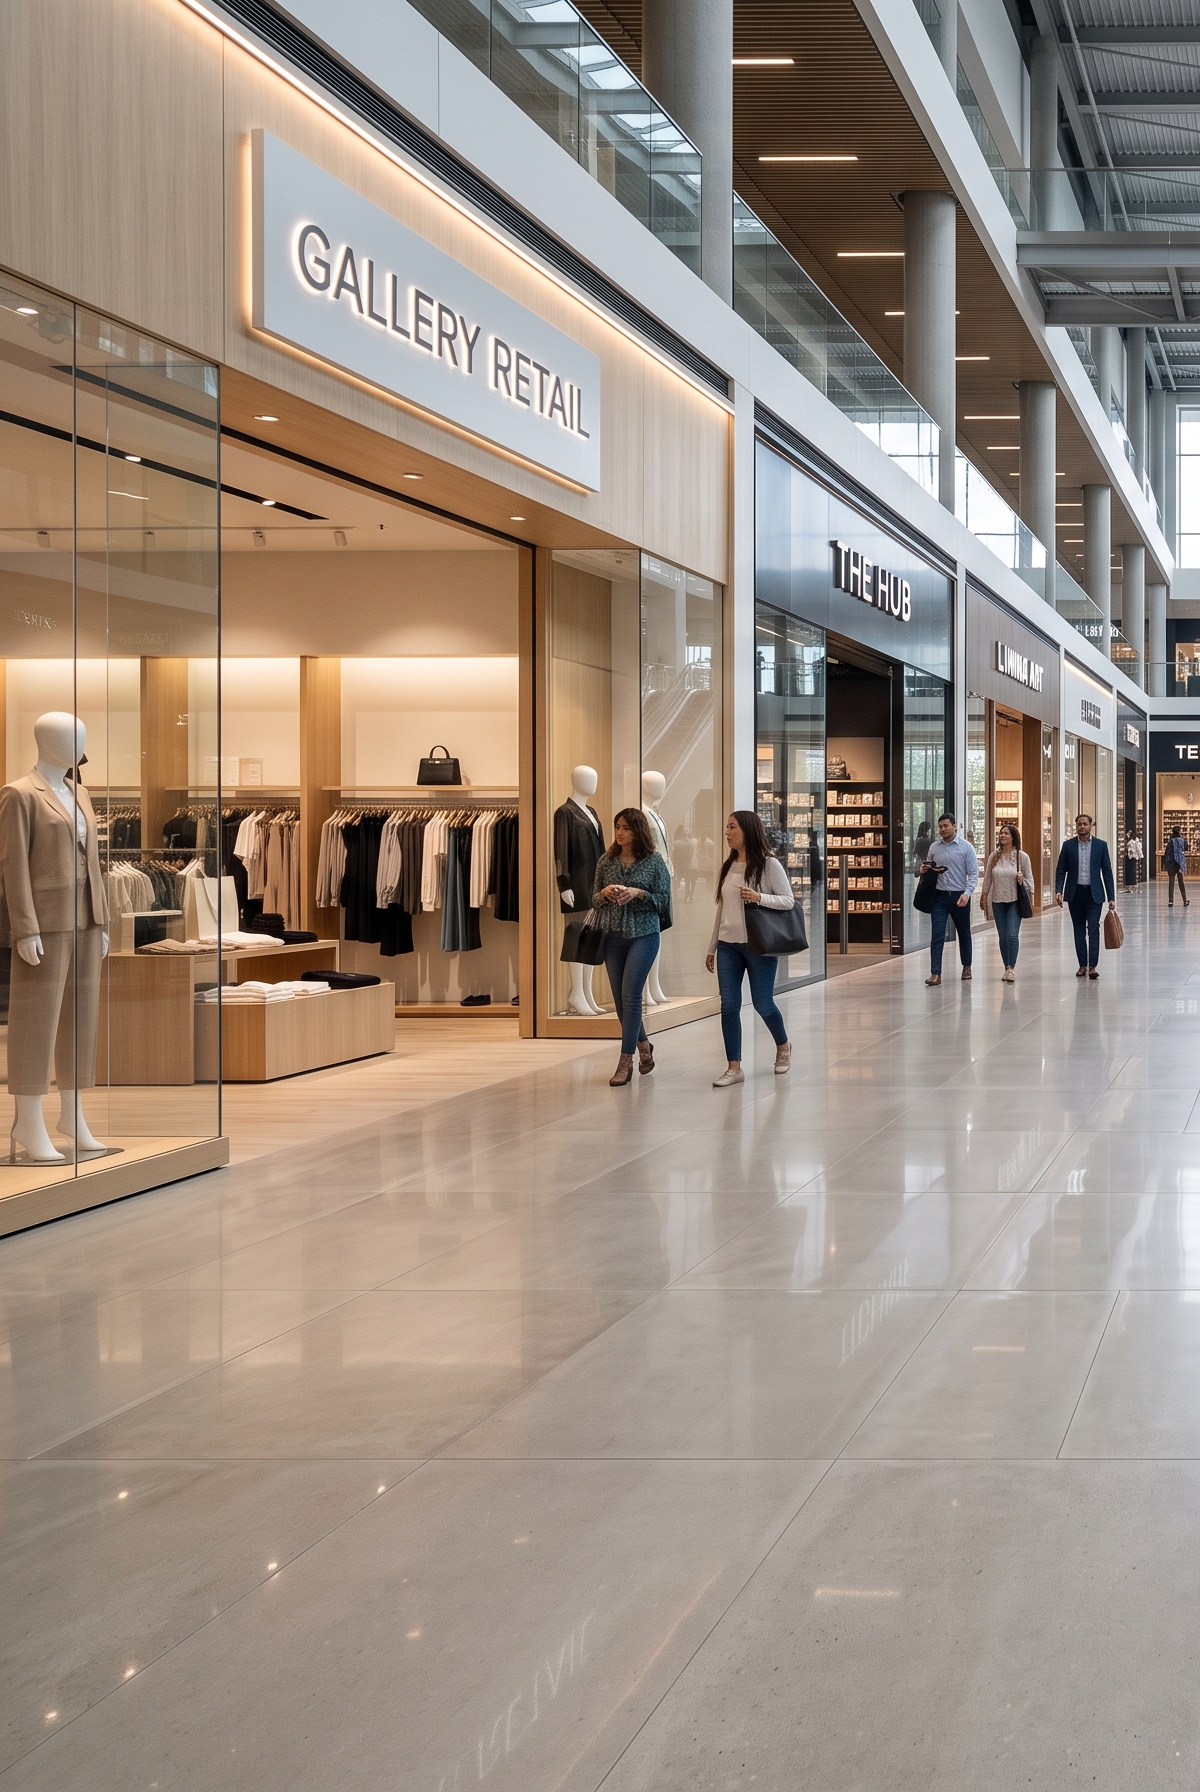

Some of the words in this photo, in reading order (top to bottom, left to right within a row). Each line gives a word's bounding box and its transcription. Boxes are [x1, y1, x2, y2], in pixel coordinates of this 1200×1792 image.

[297, 223, 481, 375] GALLERY
[492, 336, 590, 439] RETAIL
[831, 540, 873, 603] THE
[876, 566, 912, 622] HUB
